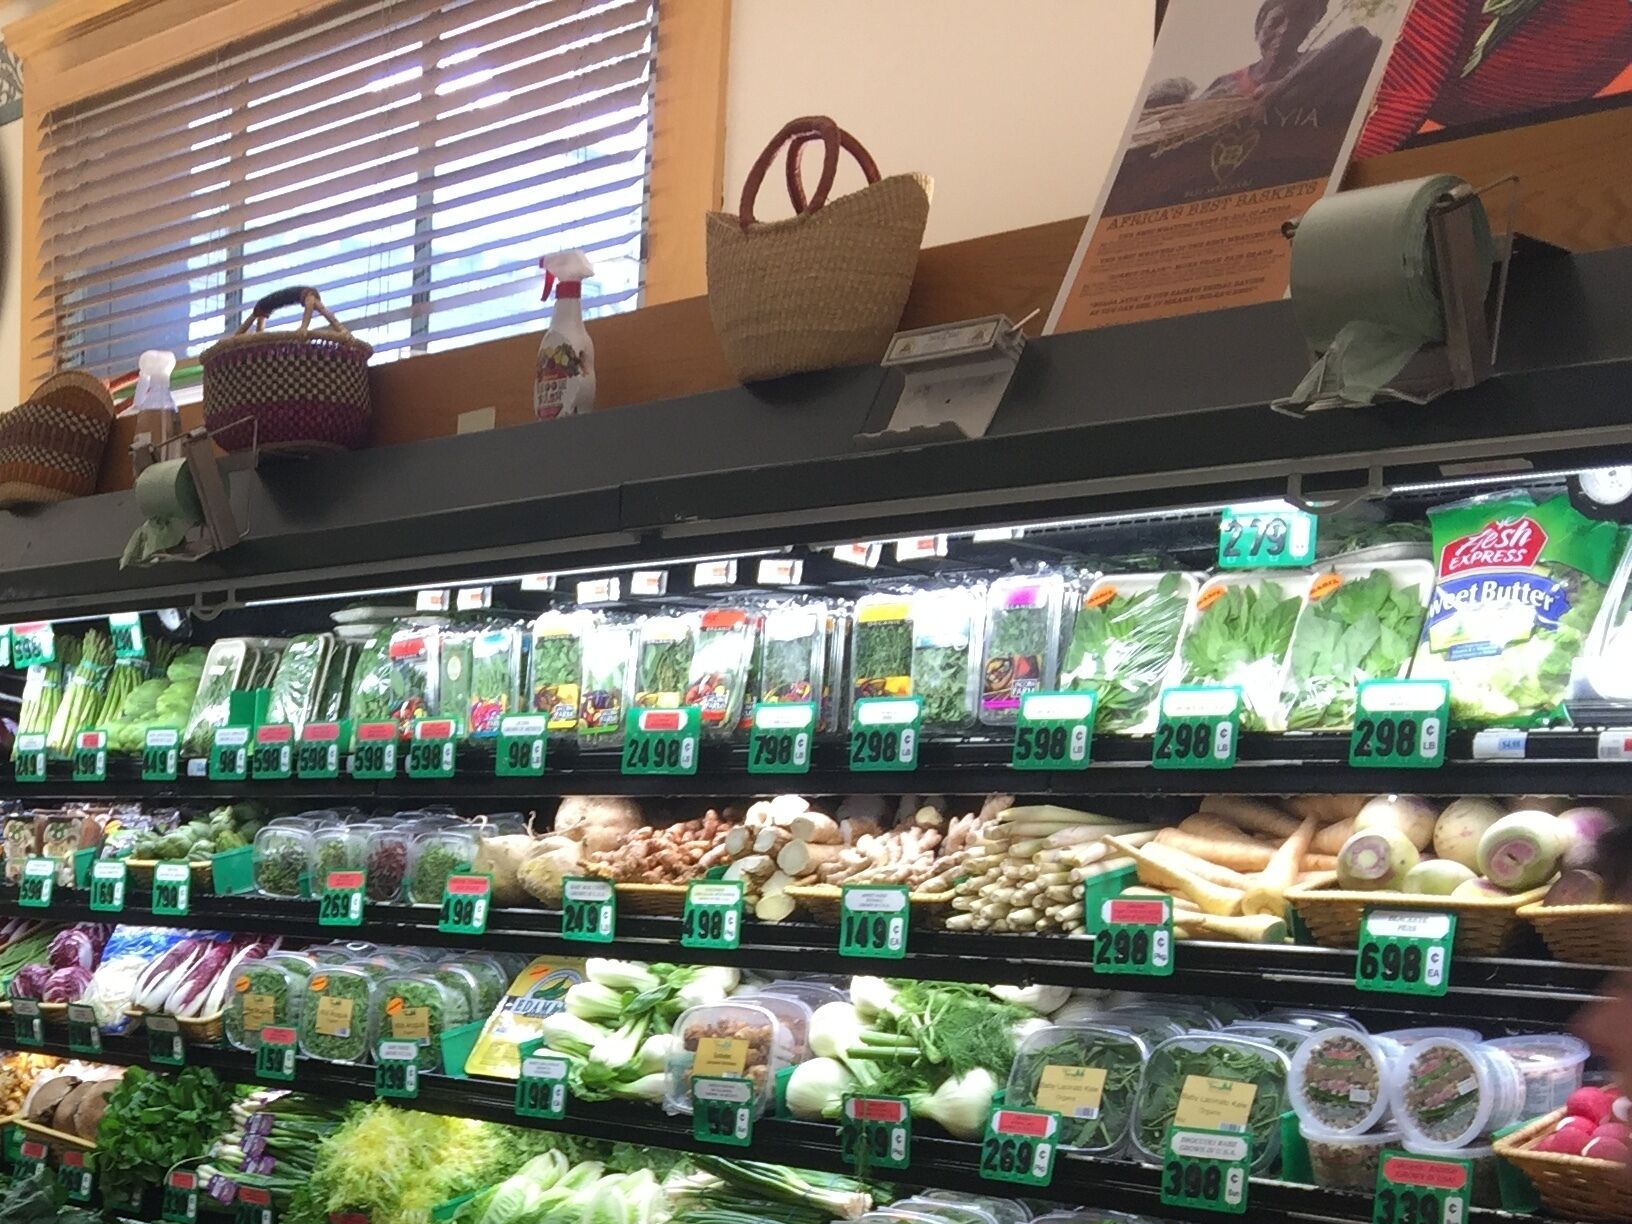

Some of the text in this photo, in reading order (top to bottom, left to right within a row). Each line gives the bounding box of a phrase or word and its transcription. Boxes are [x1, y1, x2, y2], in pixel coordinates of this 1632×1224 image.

[1187, 199, 1233, 219] BEST
[1234, 181, 1319, 208] BASKETS
[1222, 517, 1288, 558] 279
[1448, 548, 1528, 571] EXPRESS
[1481, 580, 1555, 612] Butter
[753, 735, 792, 765] 798
[852, 726, 899, 763] 298
[1017, 726, 1068, 761] 598
[1155, 722, 1212, 760] 298
[1354, 719, 1417, 758] 298
[1423, 741, 1436, 750] LB
[843, 914, 886, 949] 149
[1096, 930, 1149, 966] 298
[1359, 942, 1422, 983] 698
